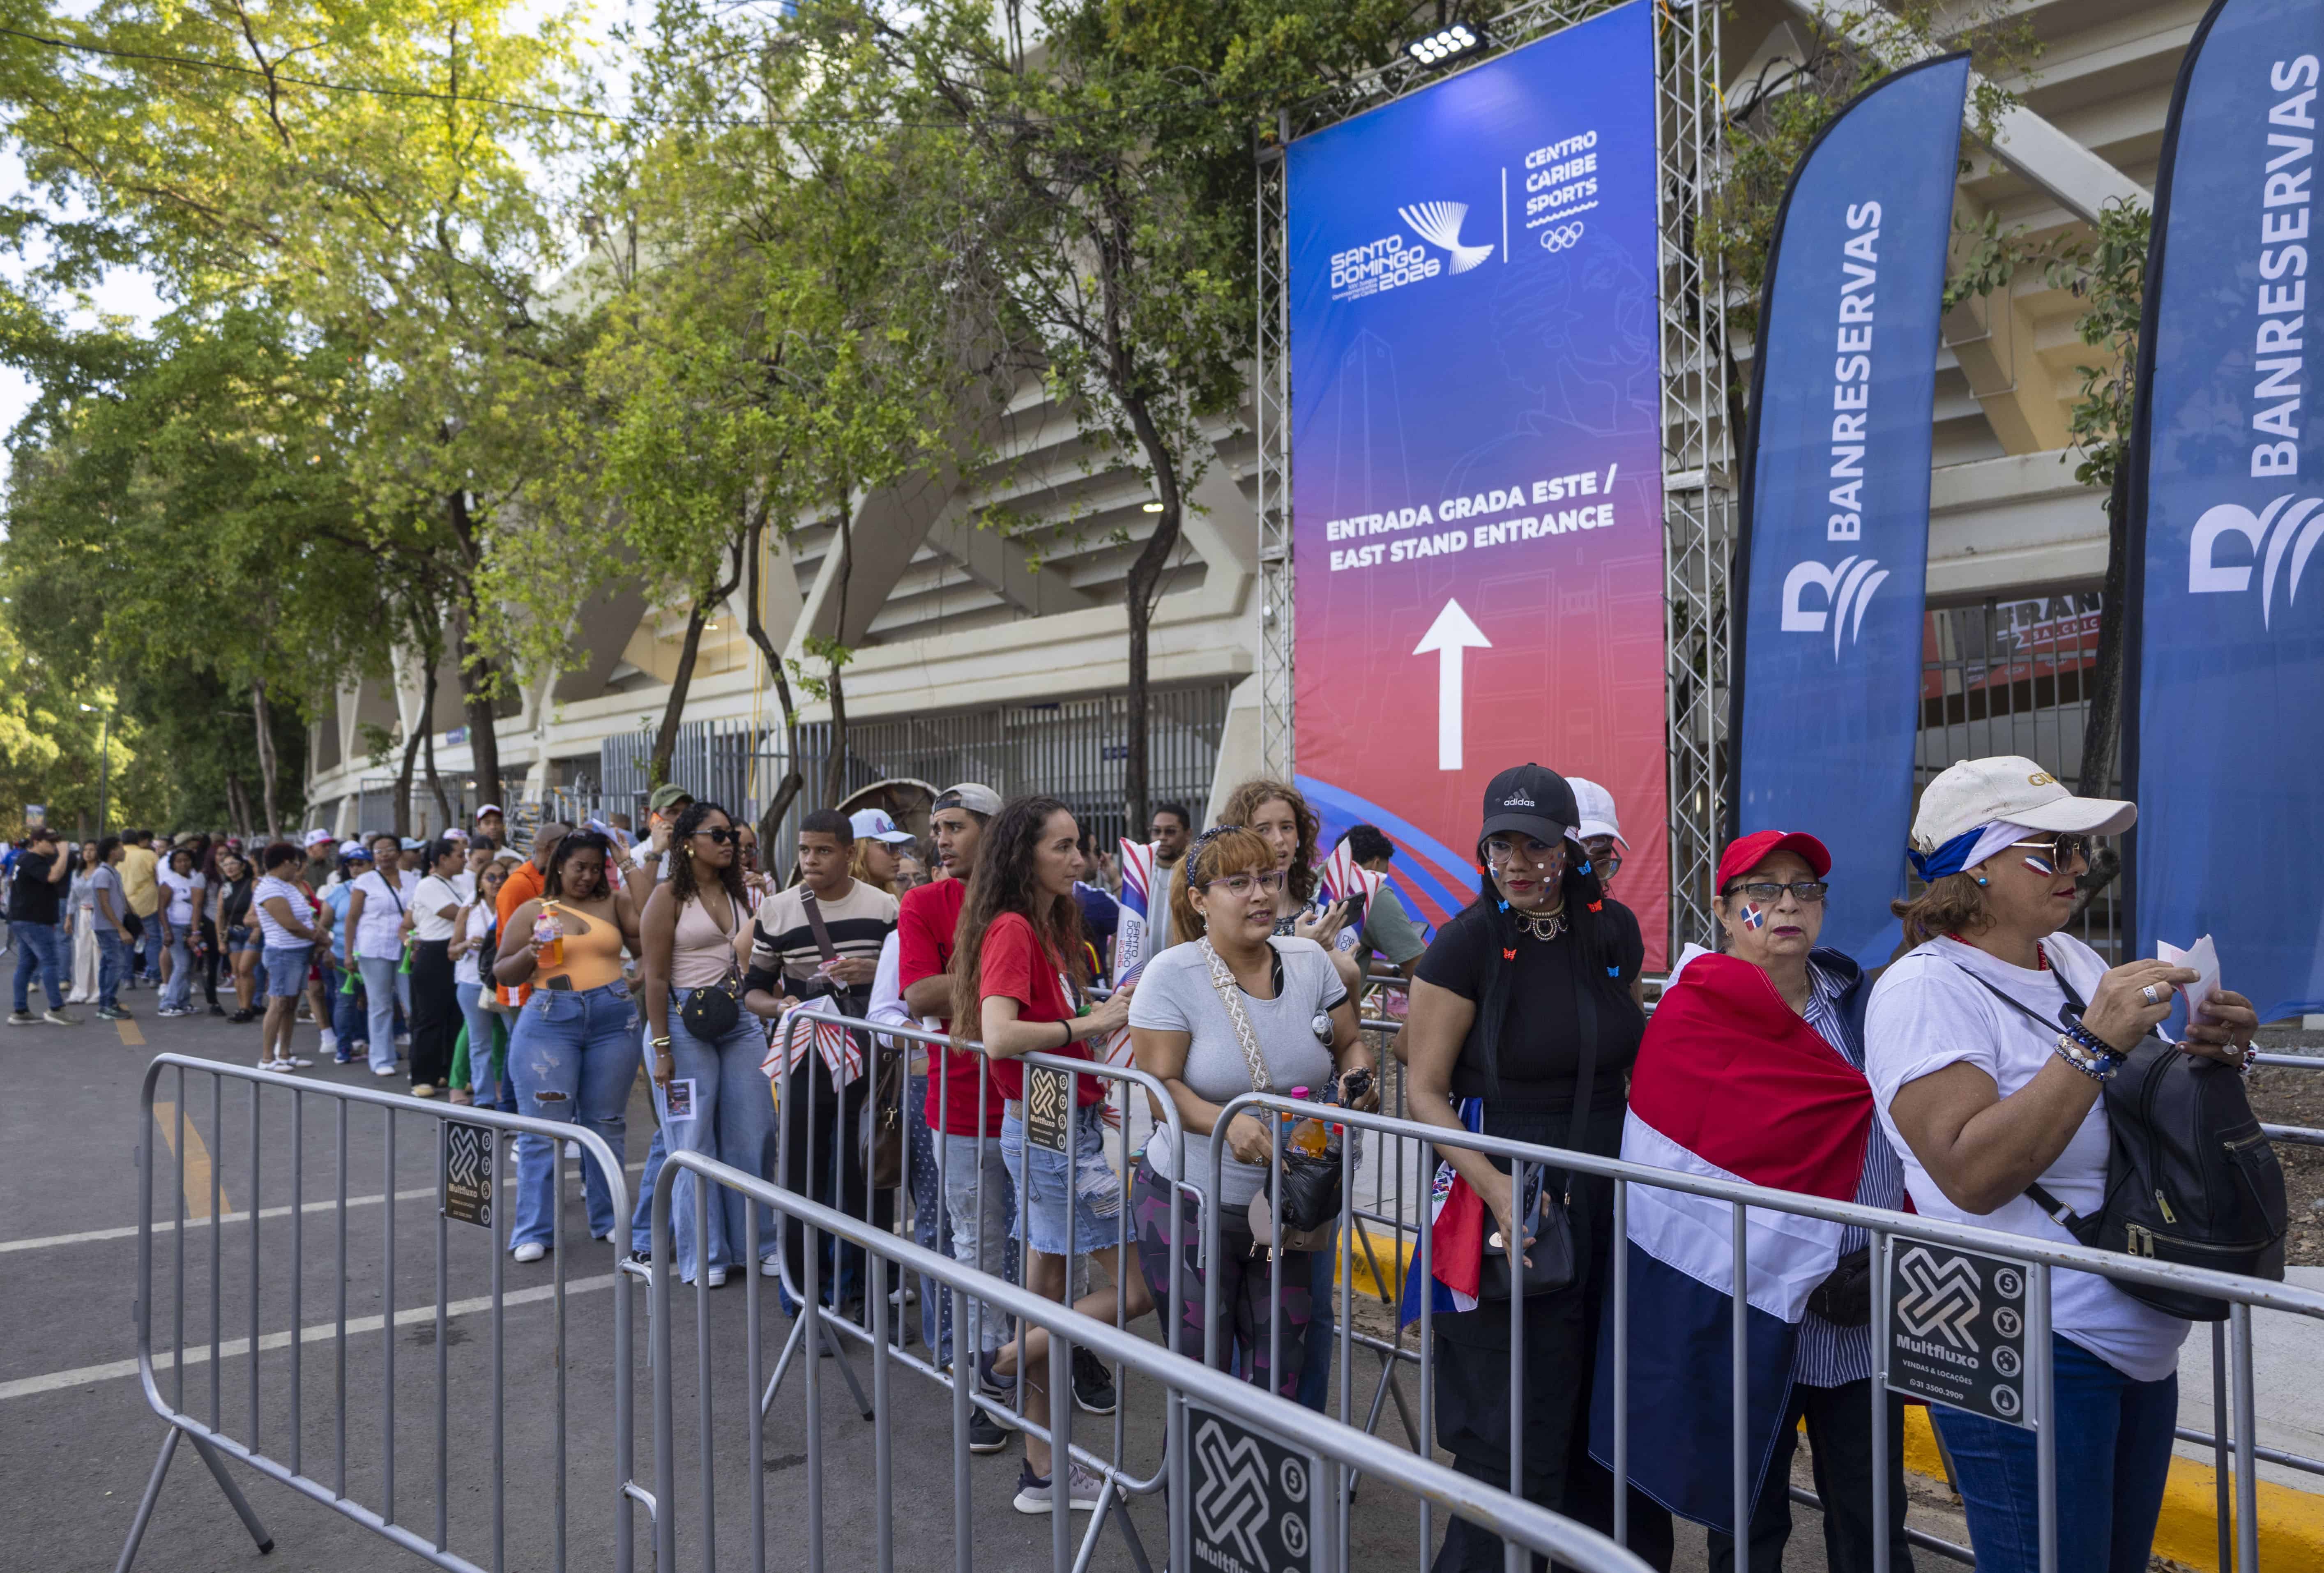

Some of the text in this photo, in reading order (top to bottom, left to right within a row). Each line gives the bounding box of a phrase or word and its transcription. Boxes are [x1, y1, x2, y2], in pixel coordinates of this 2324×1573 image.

[1525, 131, 1597, 169] CENTRO
[1526, 153, 1597, 192] CARIBE
[1527, 177, 1597, 216] SPORTS
[1331, 234, 1402, 272] SANTO
[1331, 245, 1425, 288] DOMINGO
[2251, 55, 2319, 477] BANRESERVAS
[1379, 258, 1441, 291] 2026
[1827, 200, 1882, 541] BANRESERVAS
[1326, 463, 1618, 541] ENTRADA GRADA ESTE /
[1330, 502, 1615, 571] EAST STAND ENTRANCE
[1504, 798, 1535, 807] adidas
[1124, 920, 1134, 967] DOMINGO
[1131, 920, 1140, 958] SANTO
[1030, 1114, 1055, 1128] Multfluxo
[2004, 1276, 2013, 1290] 5
[1896, 1334, 1979, 1369] Multfluxo
[1903, 1359, 1929, 1373] VENDAS
[1937, 1369, 1972, 1385] LOCAÇÕES
[1916, 1380, 1964, 1400] 31 3500.2909
